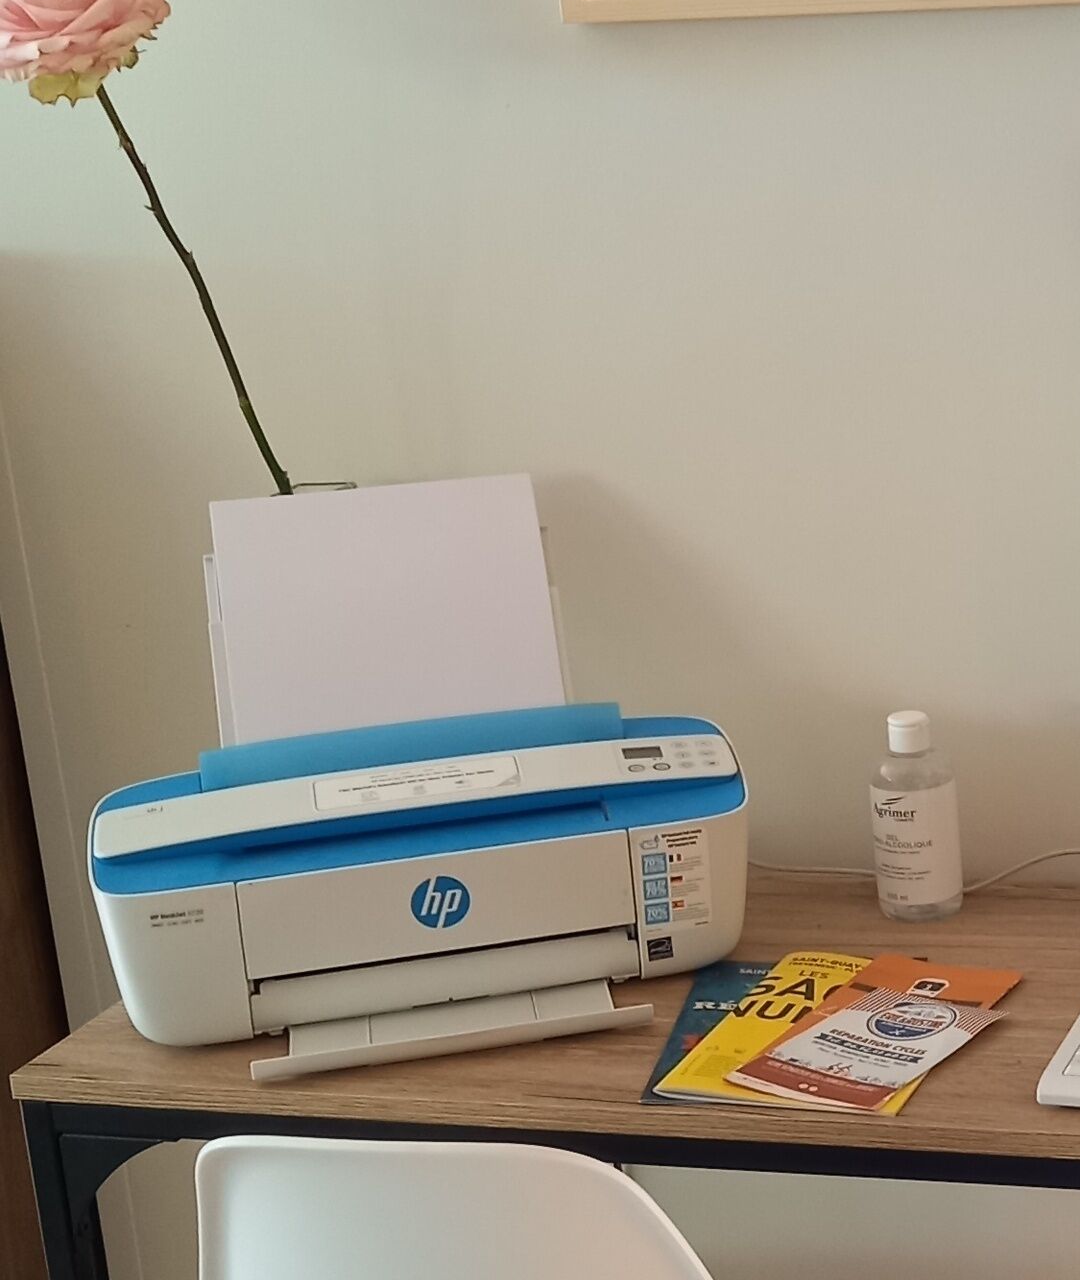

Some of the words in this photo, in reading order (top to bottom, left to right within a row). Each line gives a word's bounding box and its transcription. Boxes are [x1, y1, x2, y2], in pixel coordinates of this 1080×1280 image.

[874, 803, 917, 818] Agrimer
[419, 875, 463, 928] hp
[739, 967, 768, 975] SAIN
[829, 1028, 893, 1049] RÉPARATION
[893, 1044, 928, 1056] CYCLES
